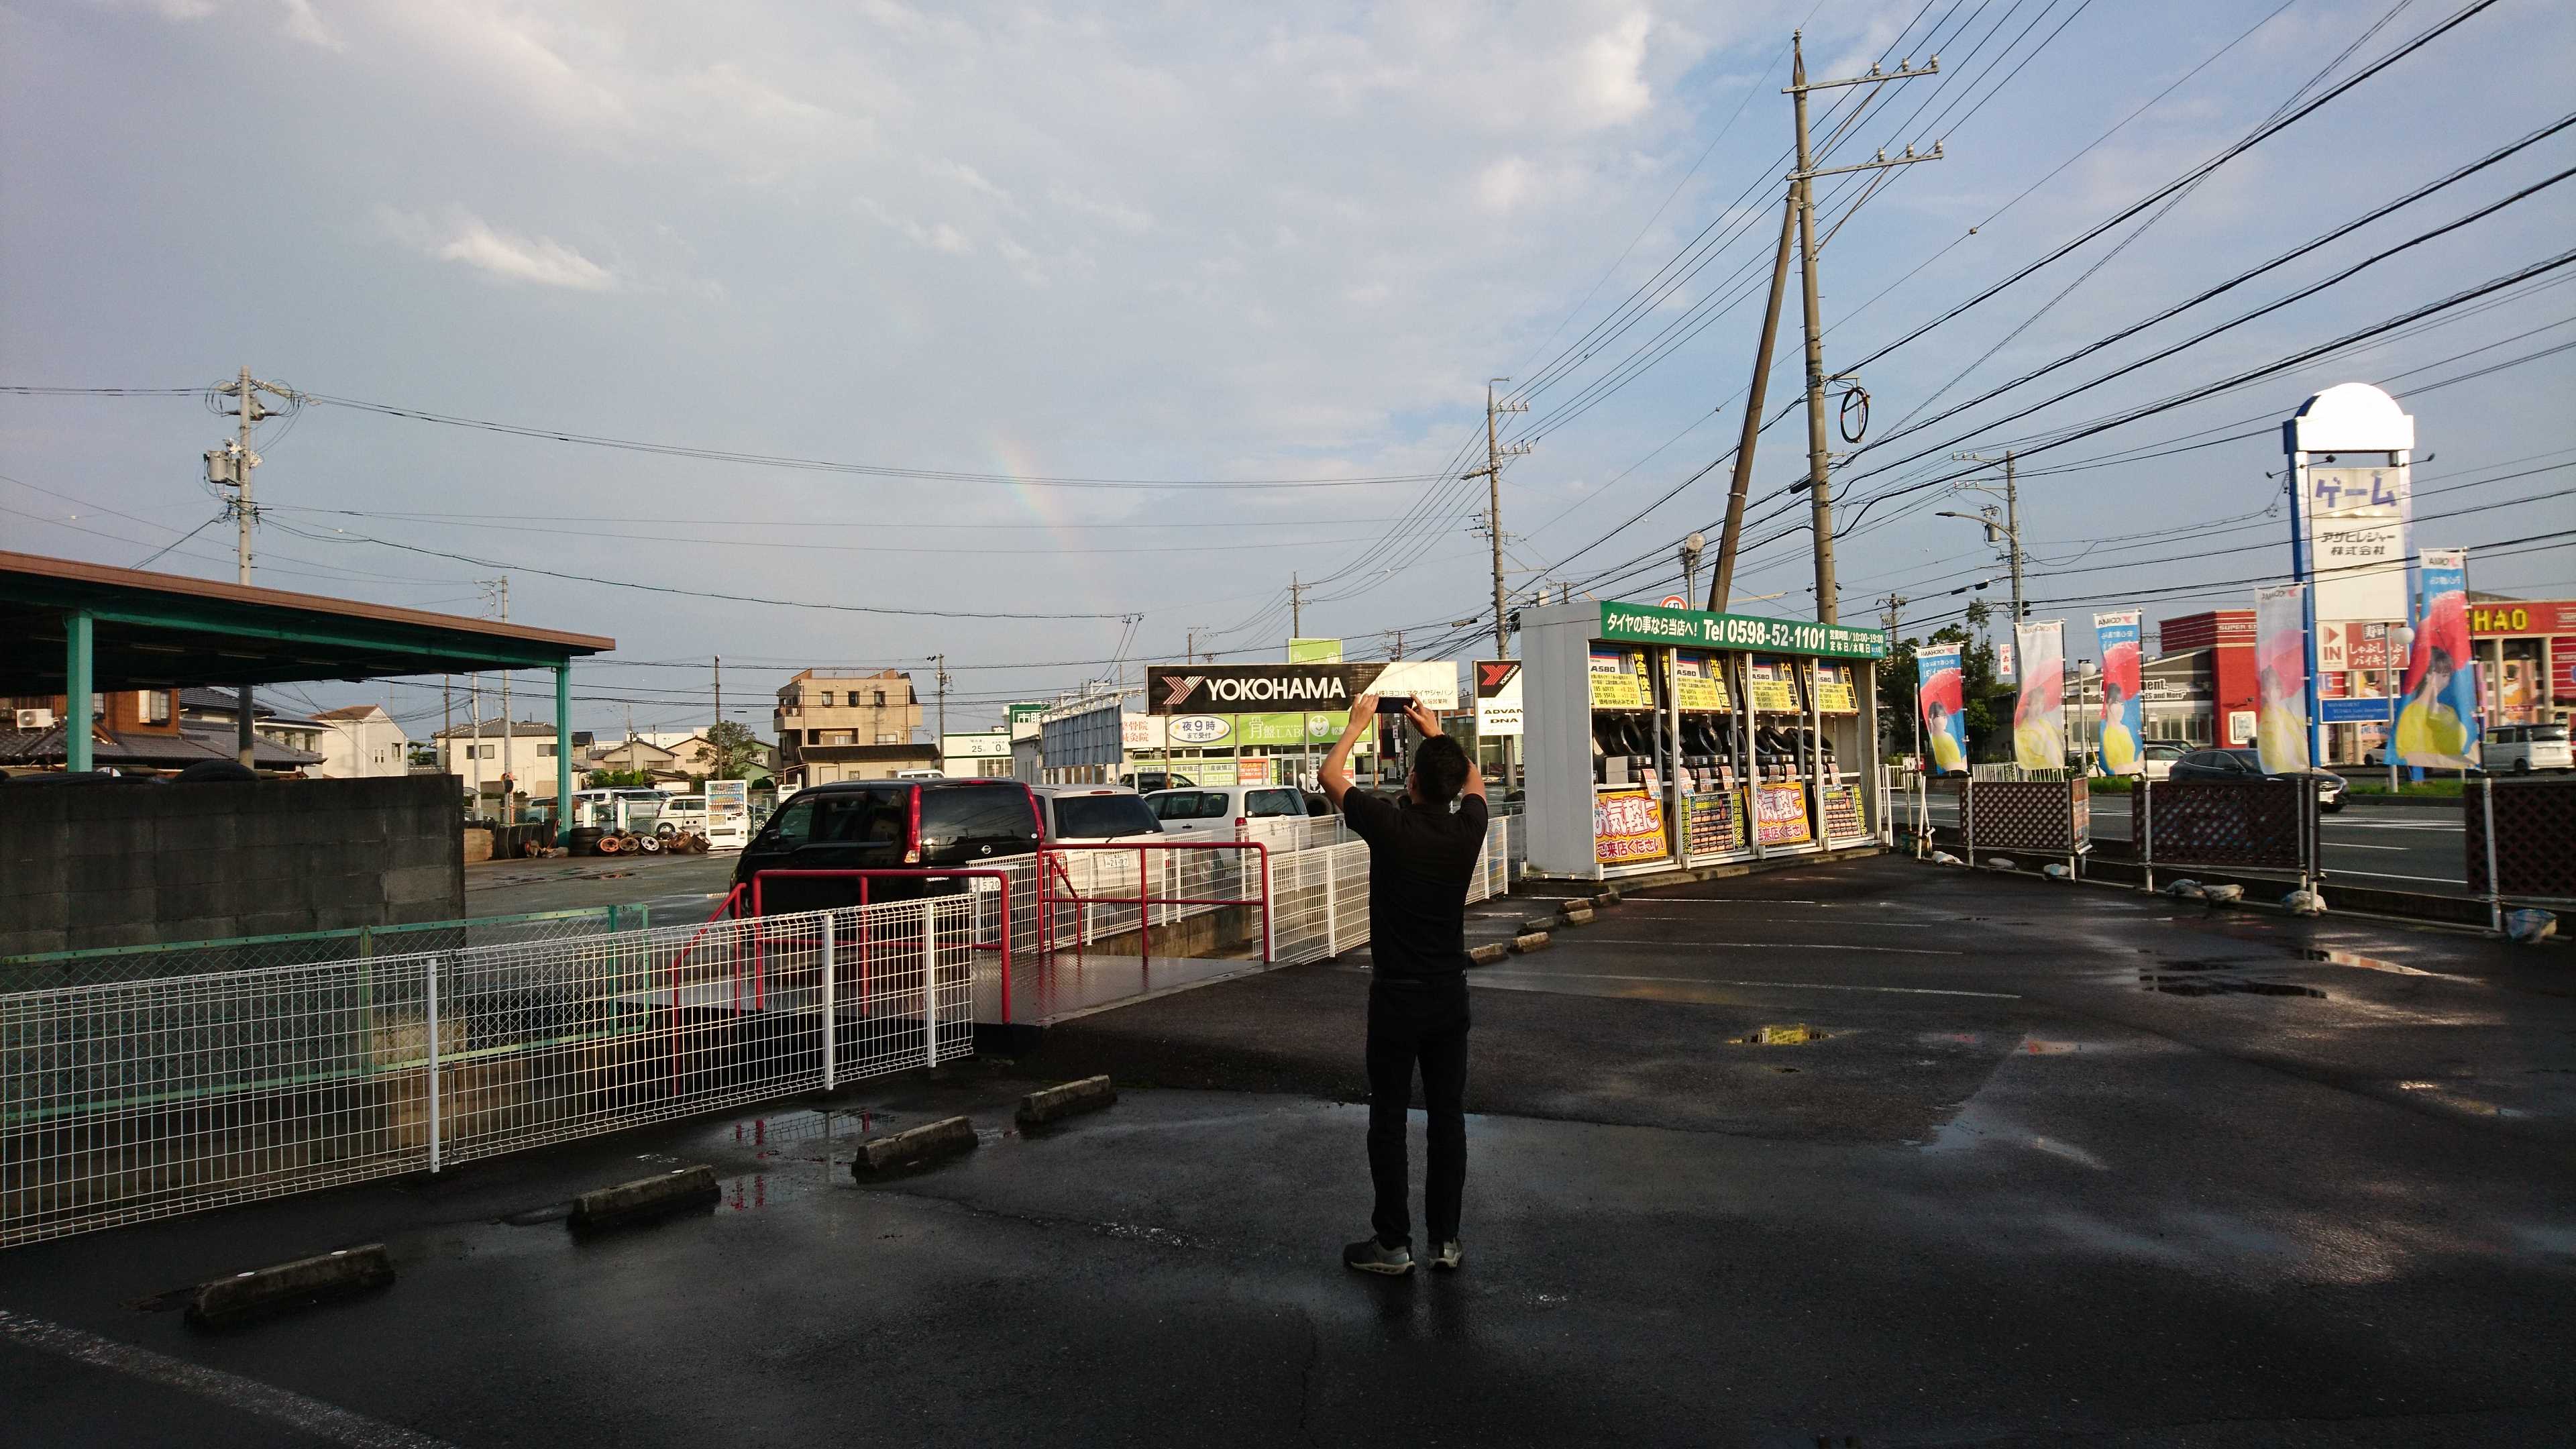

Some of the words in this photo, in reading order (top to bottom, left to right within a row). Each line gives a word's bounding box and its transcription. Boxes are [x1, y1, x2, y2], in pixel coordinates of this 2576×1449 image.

[2316, 477, 2397, 508] ゲーム
[2331, 545, 2385, 555] 株式会社
[1607, 612, 1697, 637] タイヤの事なら当店へ!
[1703, 619, 1724, 641] Tel
[1727, 619, 1825, 650] 0598-52-1101
[2324, 647, 2342, 660] IN
[2349, 643, 2404, 654] しゃぶしぶ
[1499, 664, 1519, 685] YOKOHAMA
[1206, 677, 1346, 701] YOKOHAMA
[1182, 720, 1215, 732] 夜9時
[1597, 837, 1665, 859] ご来店ください
